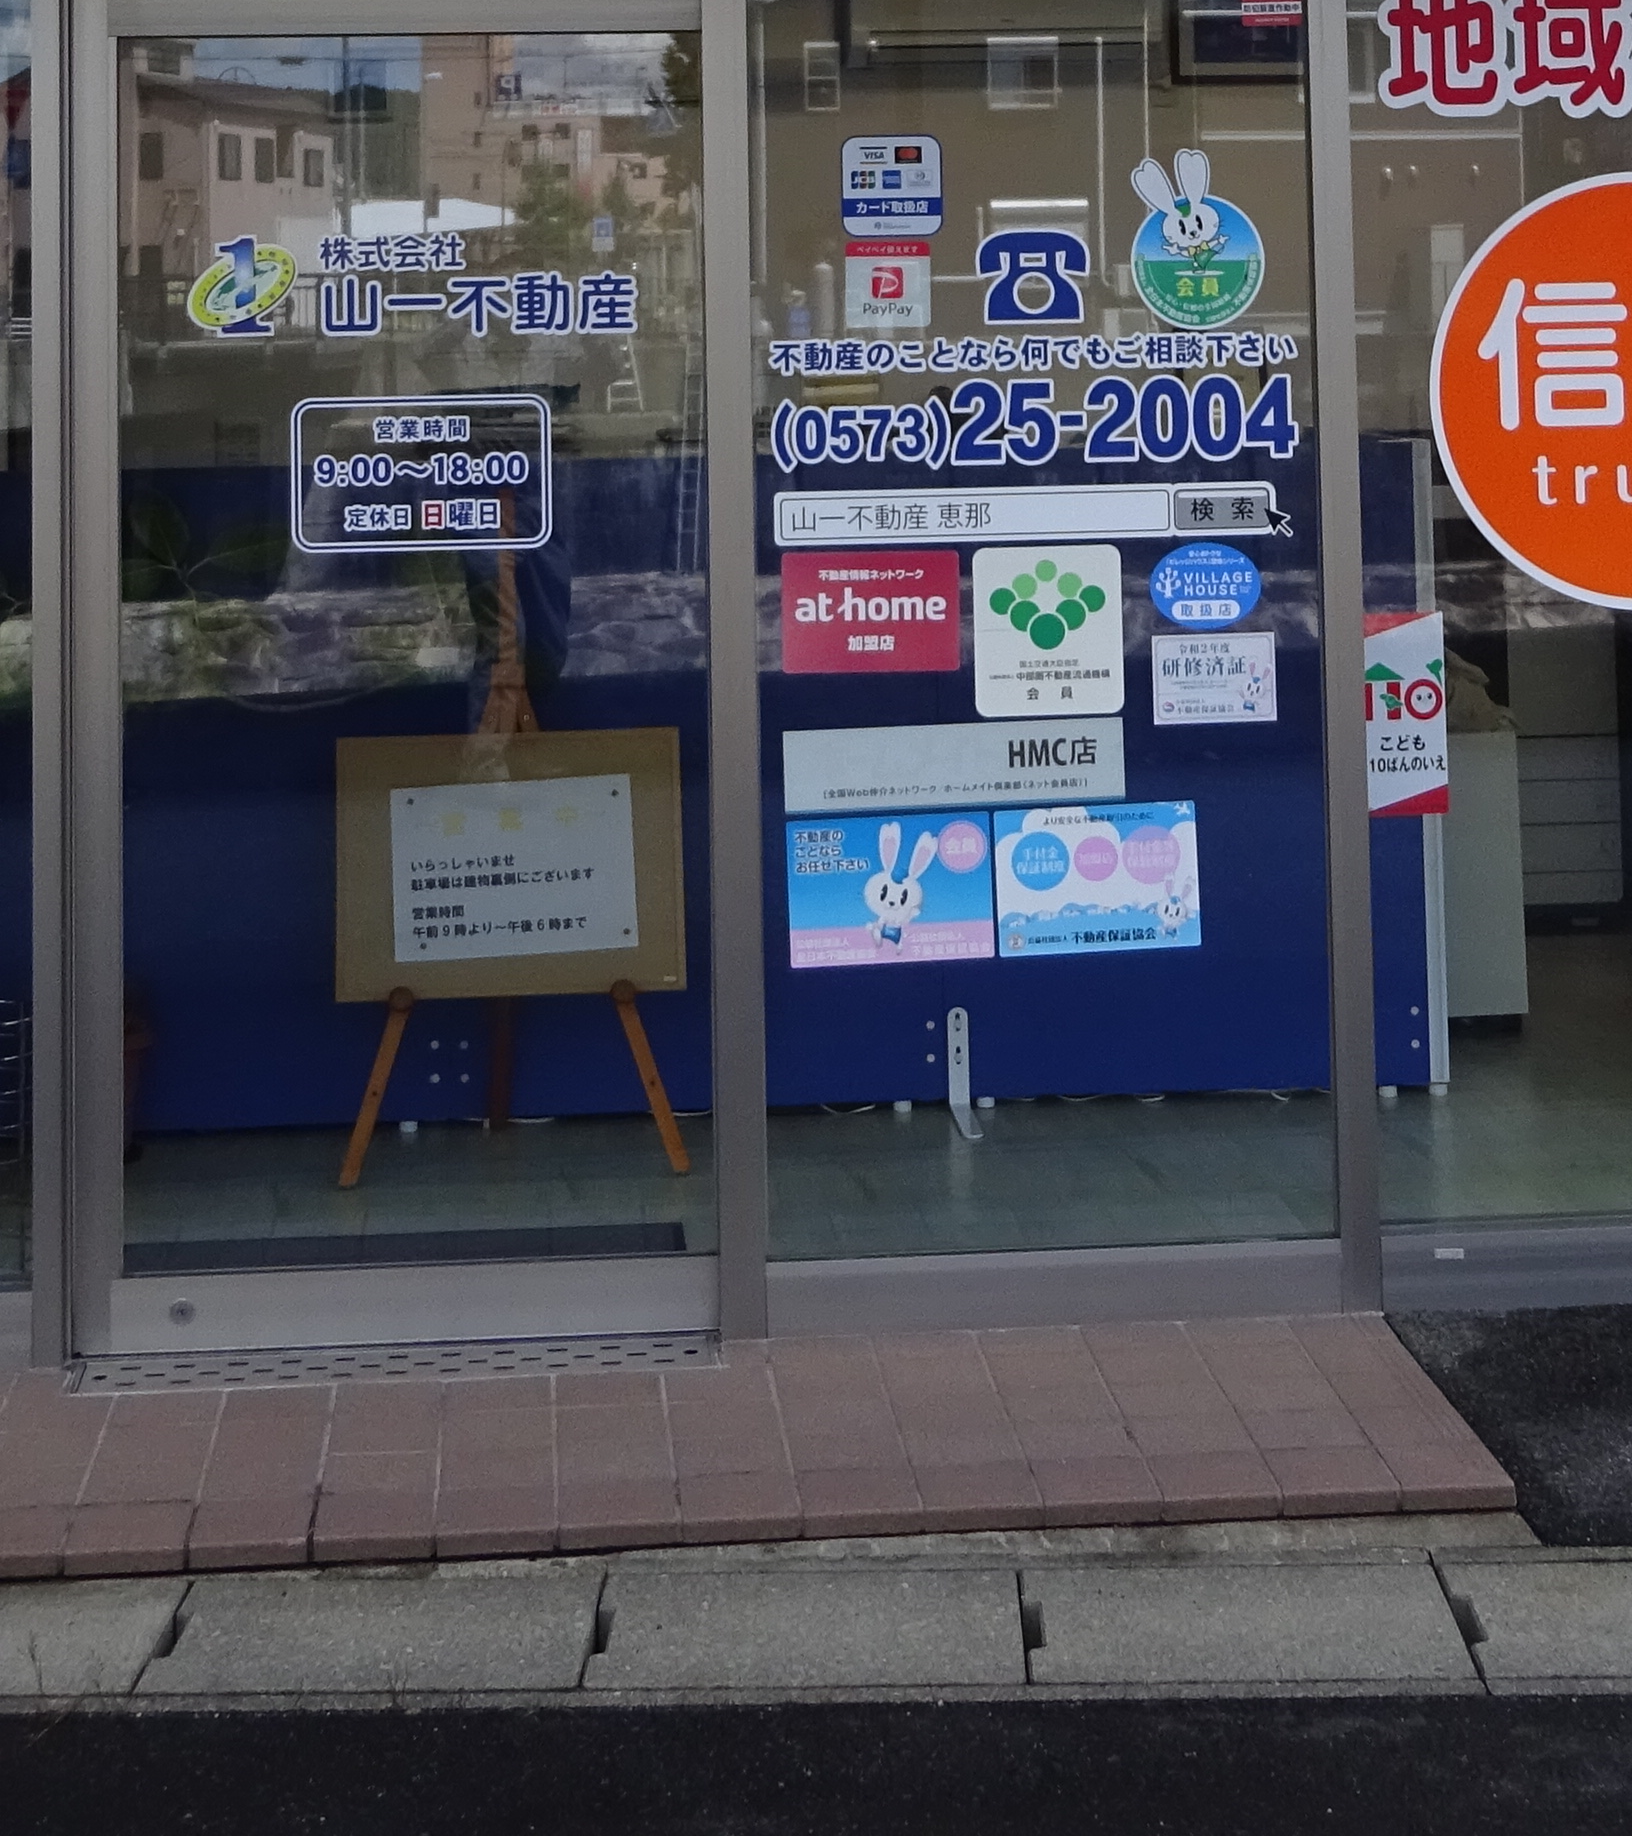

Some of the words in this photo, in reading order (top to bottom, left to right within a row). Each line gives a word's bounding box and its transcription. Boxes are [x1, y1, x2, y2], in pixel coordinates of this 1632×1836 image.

[855, 200, 929, 214] カード取扱店
[319, 233, 466, 271] 株式会社
[321, 272, 638, 336] 山一不動産
[862, 303, 914, 317] PayPay
[770, 334, 1299, 374] 不動産のことなら何でもご相談下さい
[373, 416, 470, 443] 営業時間
[770, 374, 1300, 472] (0573)25-2004
[344, 504, 412, 531] 定休日
[421, 499, 502, 530] 日曜日
[791, 503, 930, 534] 山一不動産
[937, 500, 993, 529] 恵那
[1190, 496, 1256, 523] 検索
[818, 569, 924, 581] 不動産情報ネットワーク
[1183, 571, 1253, 583] VILLAGE
[1184, 584, 1238, 596] HOUSE
[847, 635, 895, 652] 加盟店
[1162, 655, 1247, 678] 研修済証
[1026, 686, 1074, 701] 会員
[1007, 735, 1097, 768] HMC店
[1379, 734, 1426, 752] こども
[1369, 755, 1447, 773] 10ばんのいえ
[794, 829, 844, 844] 不動産の
[795, 844, 842, 858] ことなら
[411, 853, 516, 872] いらっしゃいませ
[796, 858, 870, 873] お任せ下さい
[412, 904, 465, 921] 営業時間
